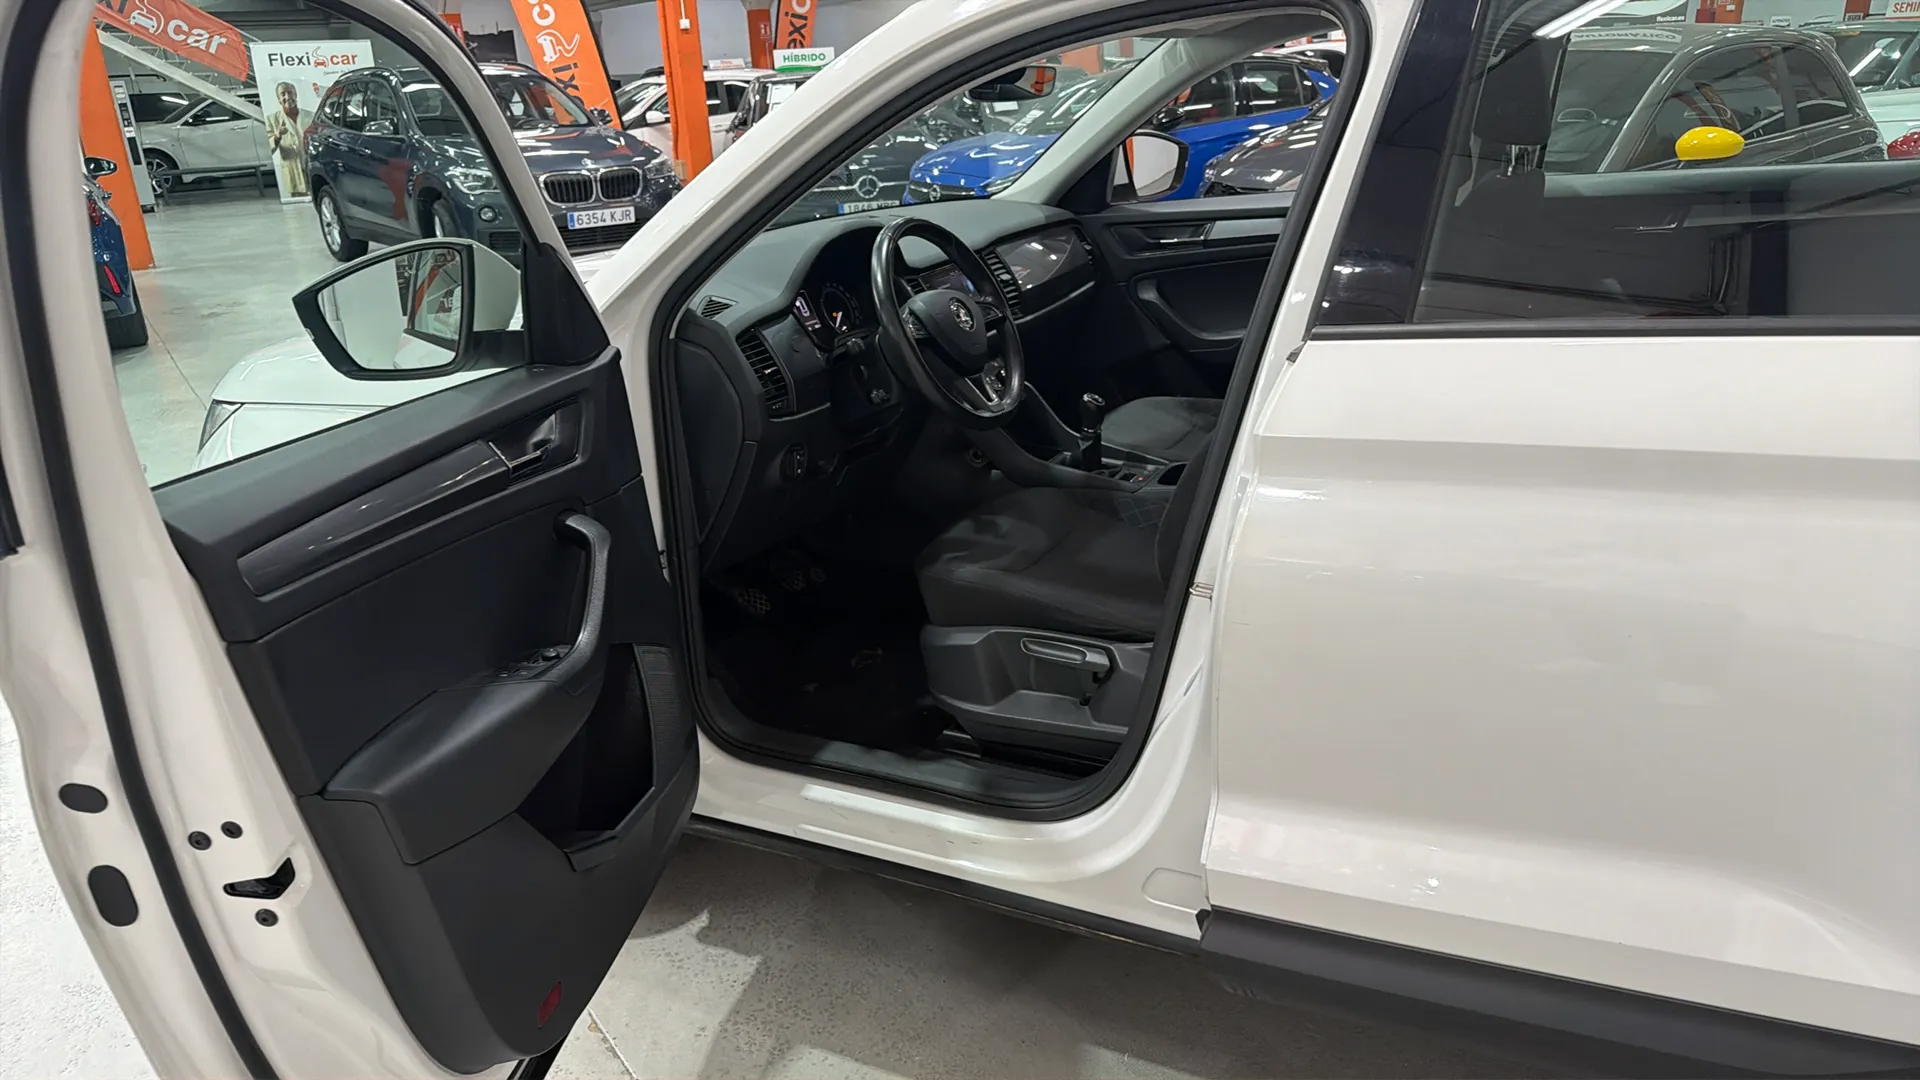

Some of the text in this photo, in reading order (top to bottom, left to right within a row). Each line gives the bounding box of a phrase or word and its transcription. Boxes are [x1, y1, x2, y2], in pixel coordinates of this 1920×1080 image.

[167, 19, 228, 54] car
[268, 52, 358, 67] Flexi car
[783, 52, 826, 63] HÍBRIDO
[576, 209, 632, 226] 6354 KJR
